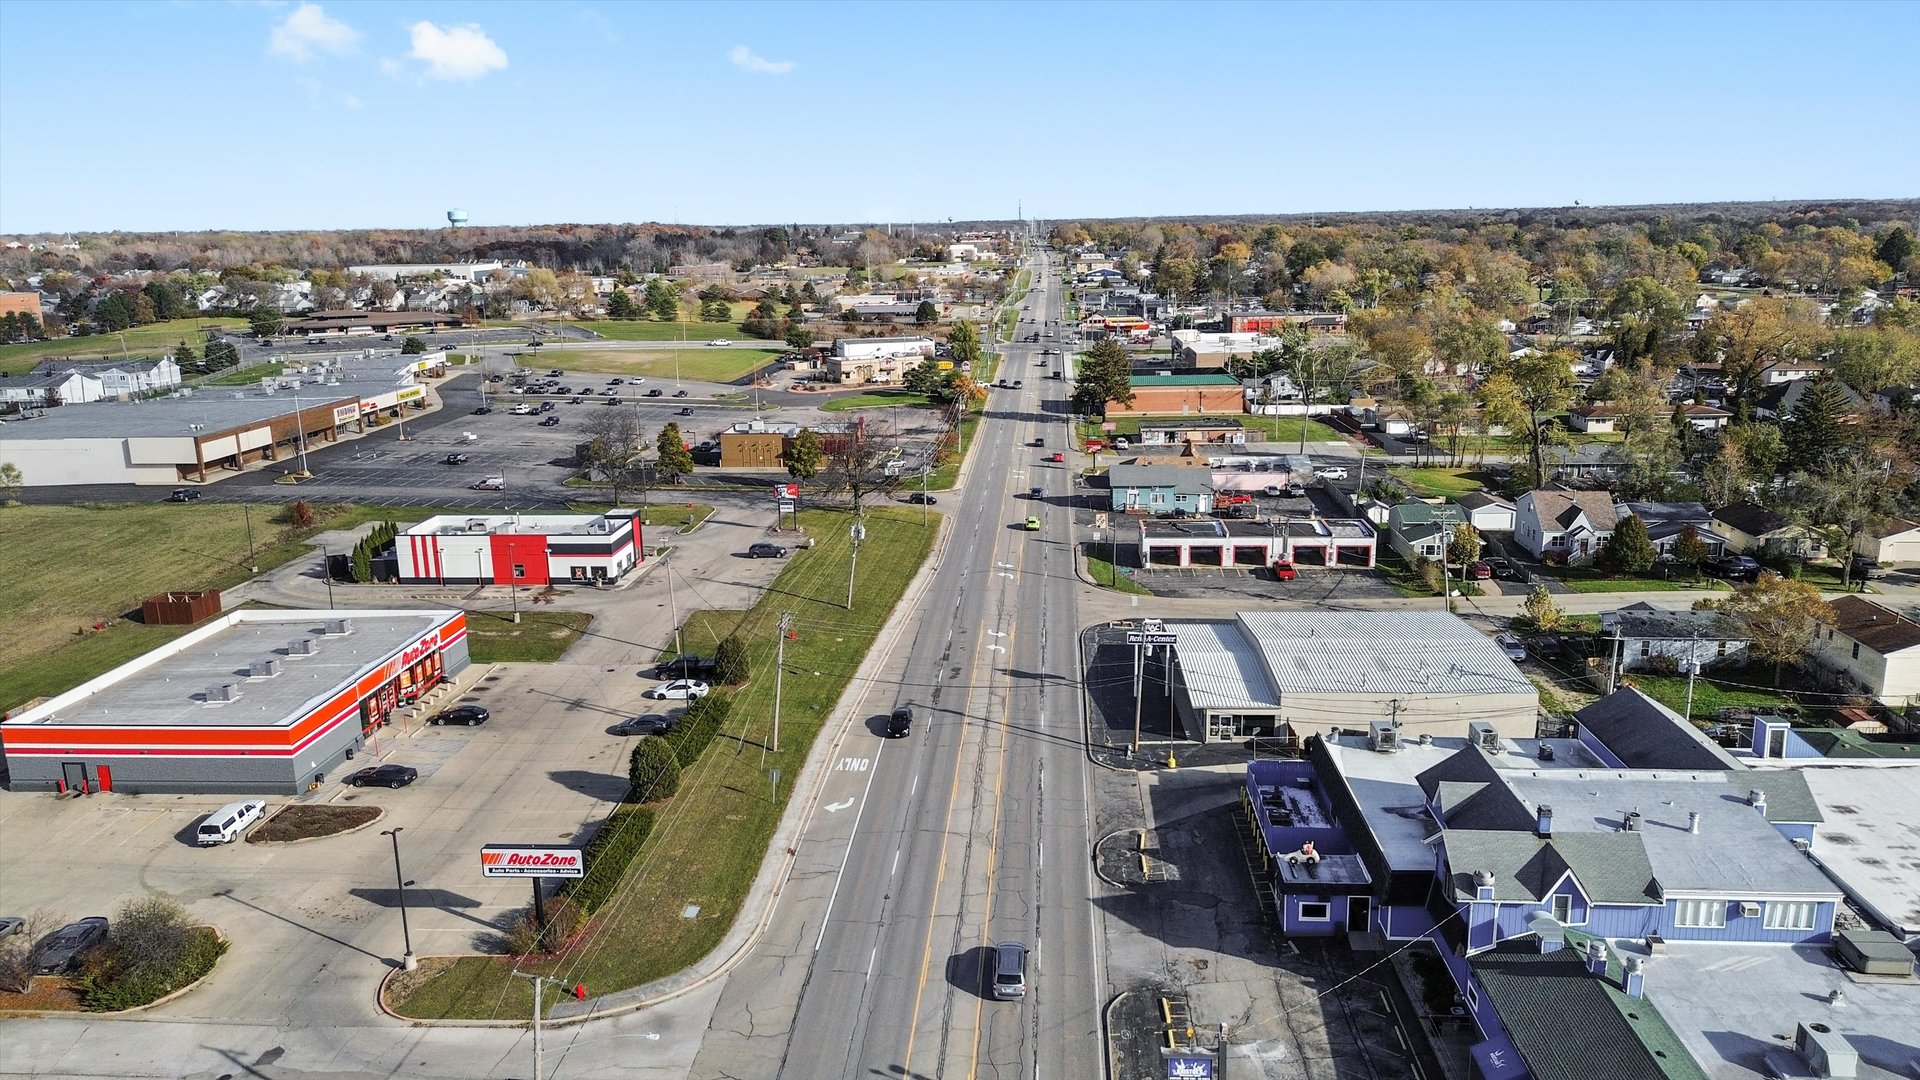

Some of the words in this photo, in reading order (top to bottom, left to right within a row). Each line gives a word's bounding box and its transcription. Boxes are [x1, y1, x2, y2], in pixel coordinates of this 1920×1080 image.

[401, 633, 439, 669] AutoZone
[834, 757, 870, 772] ONLY
[507, 853, 577, 866] AutoZone
